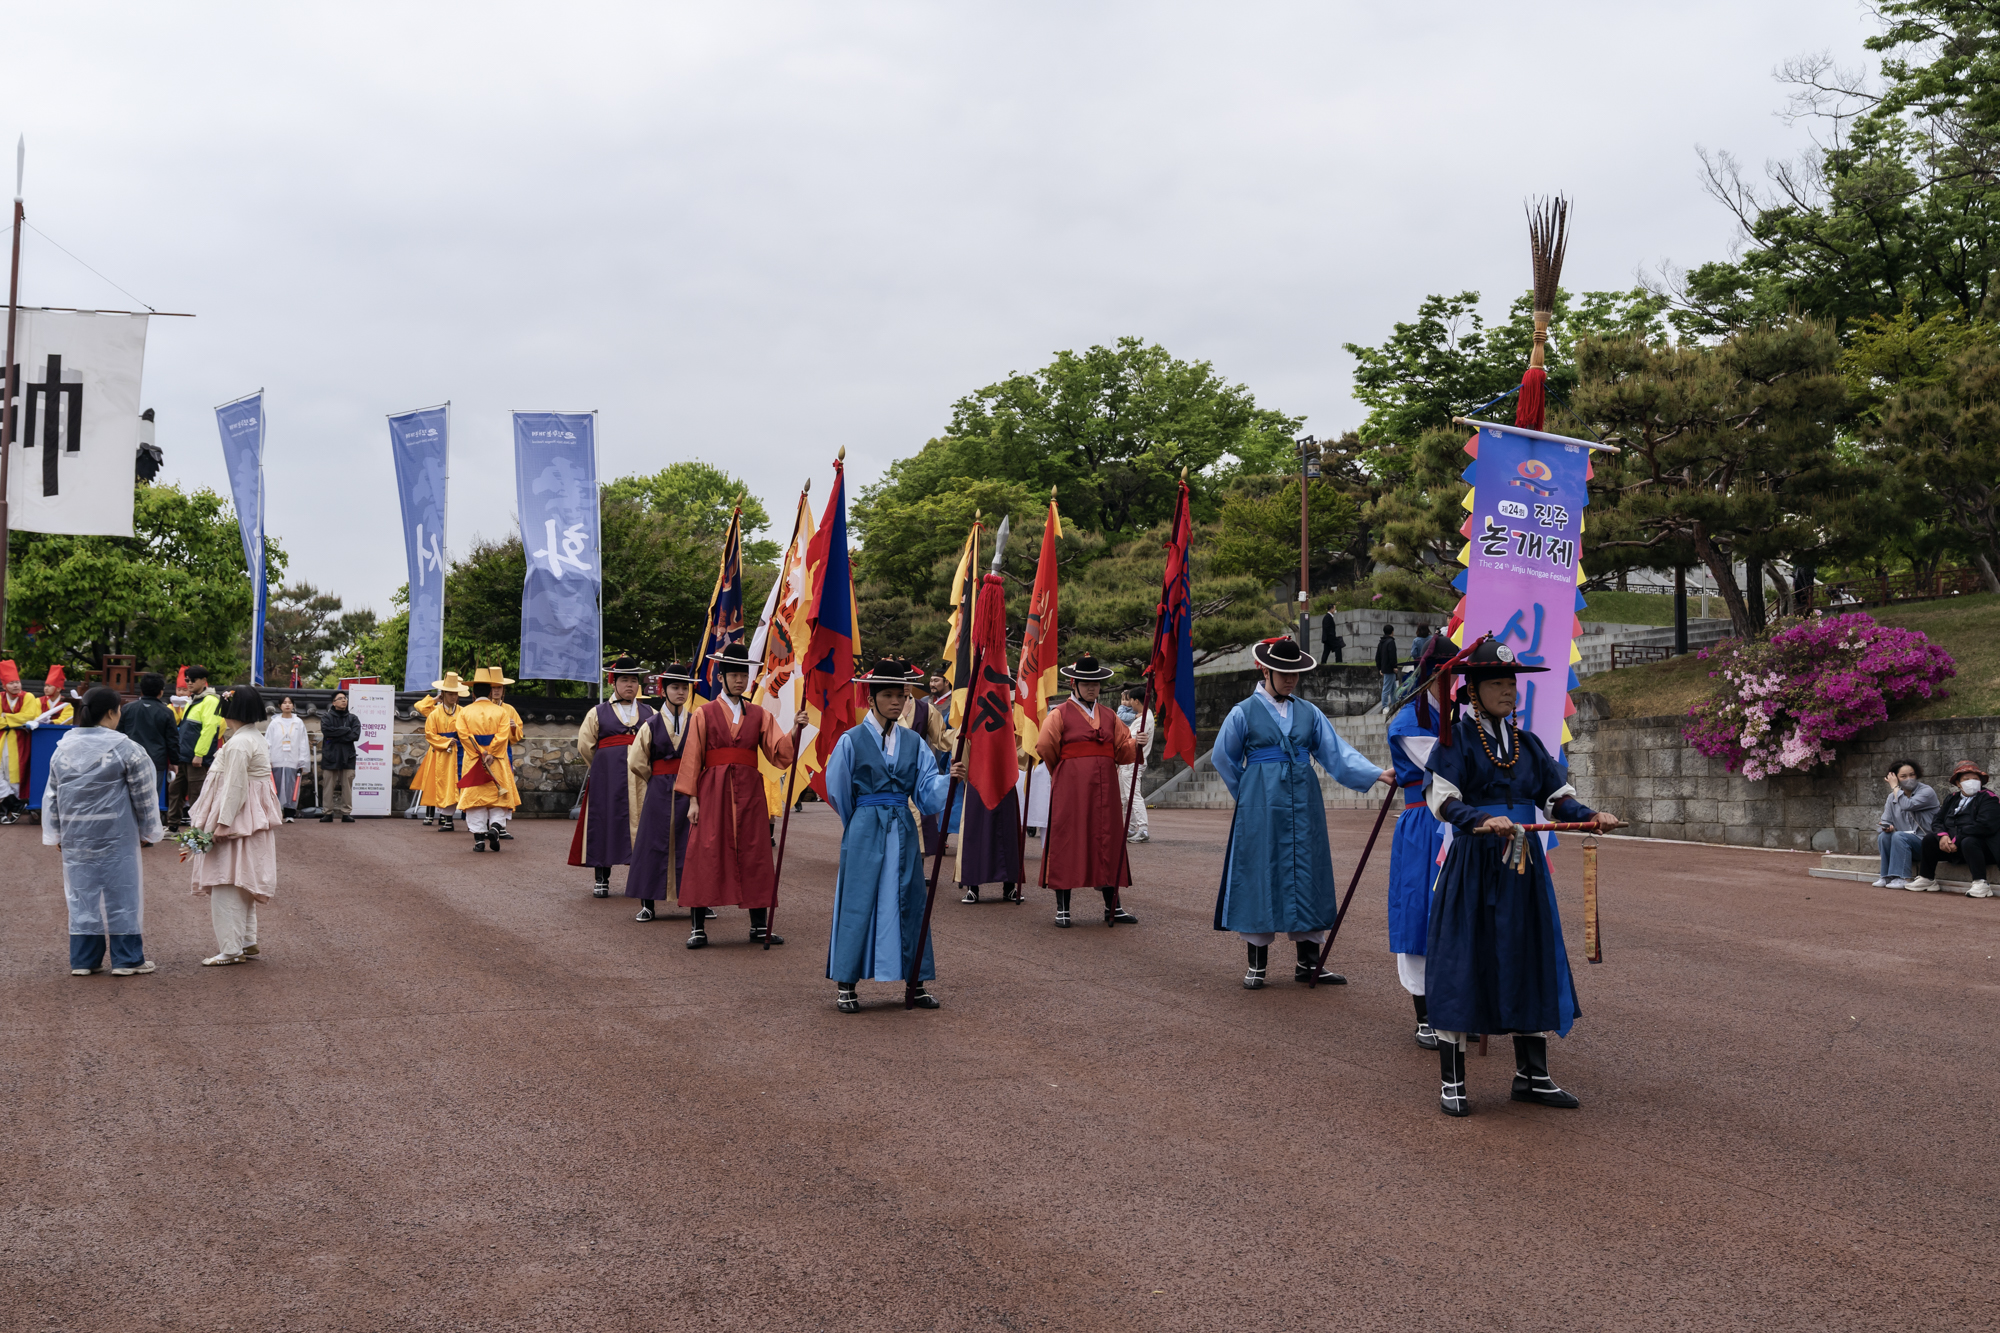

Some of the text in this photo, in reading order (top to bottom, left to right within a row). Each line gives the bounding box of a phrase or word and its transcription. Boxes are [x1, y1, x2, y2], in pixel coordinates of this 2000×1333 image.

[1534, 504, 1569, 531] 진주
[1478, 516, 1574, 569] 논개제
[1479, 559, 1493, 568] The
[1510, 565, 1526, 575] Jinju
[1526, 568, 1549, 579] Nongae
[1549, 572, 1571, 583] Festival
[364, 730, 377, 738] 확인
